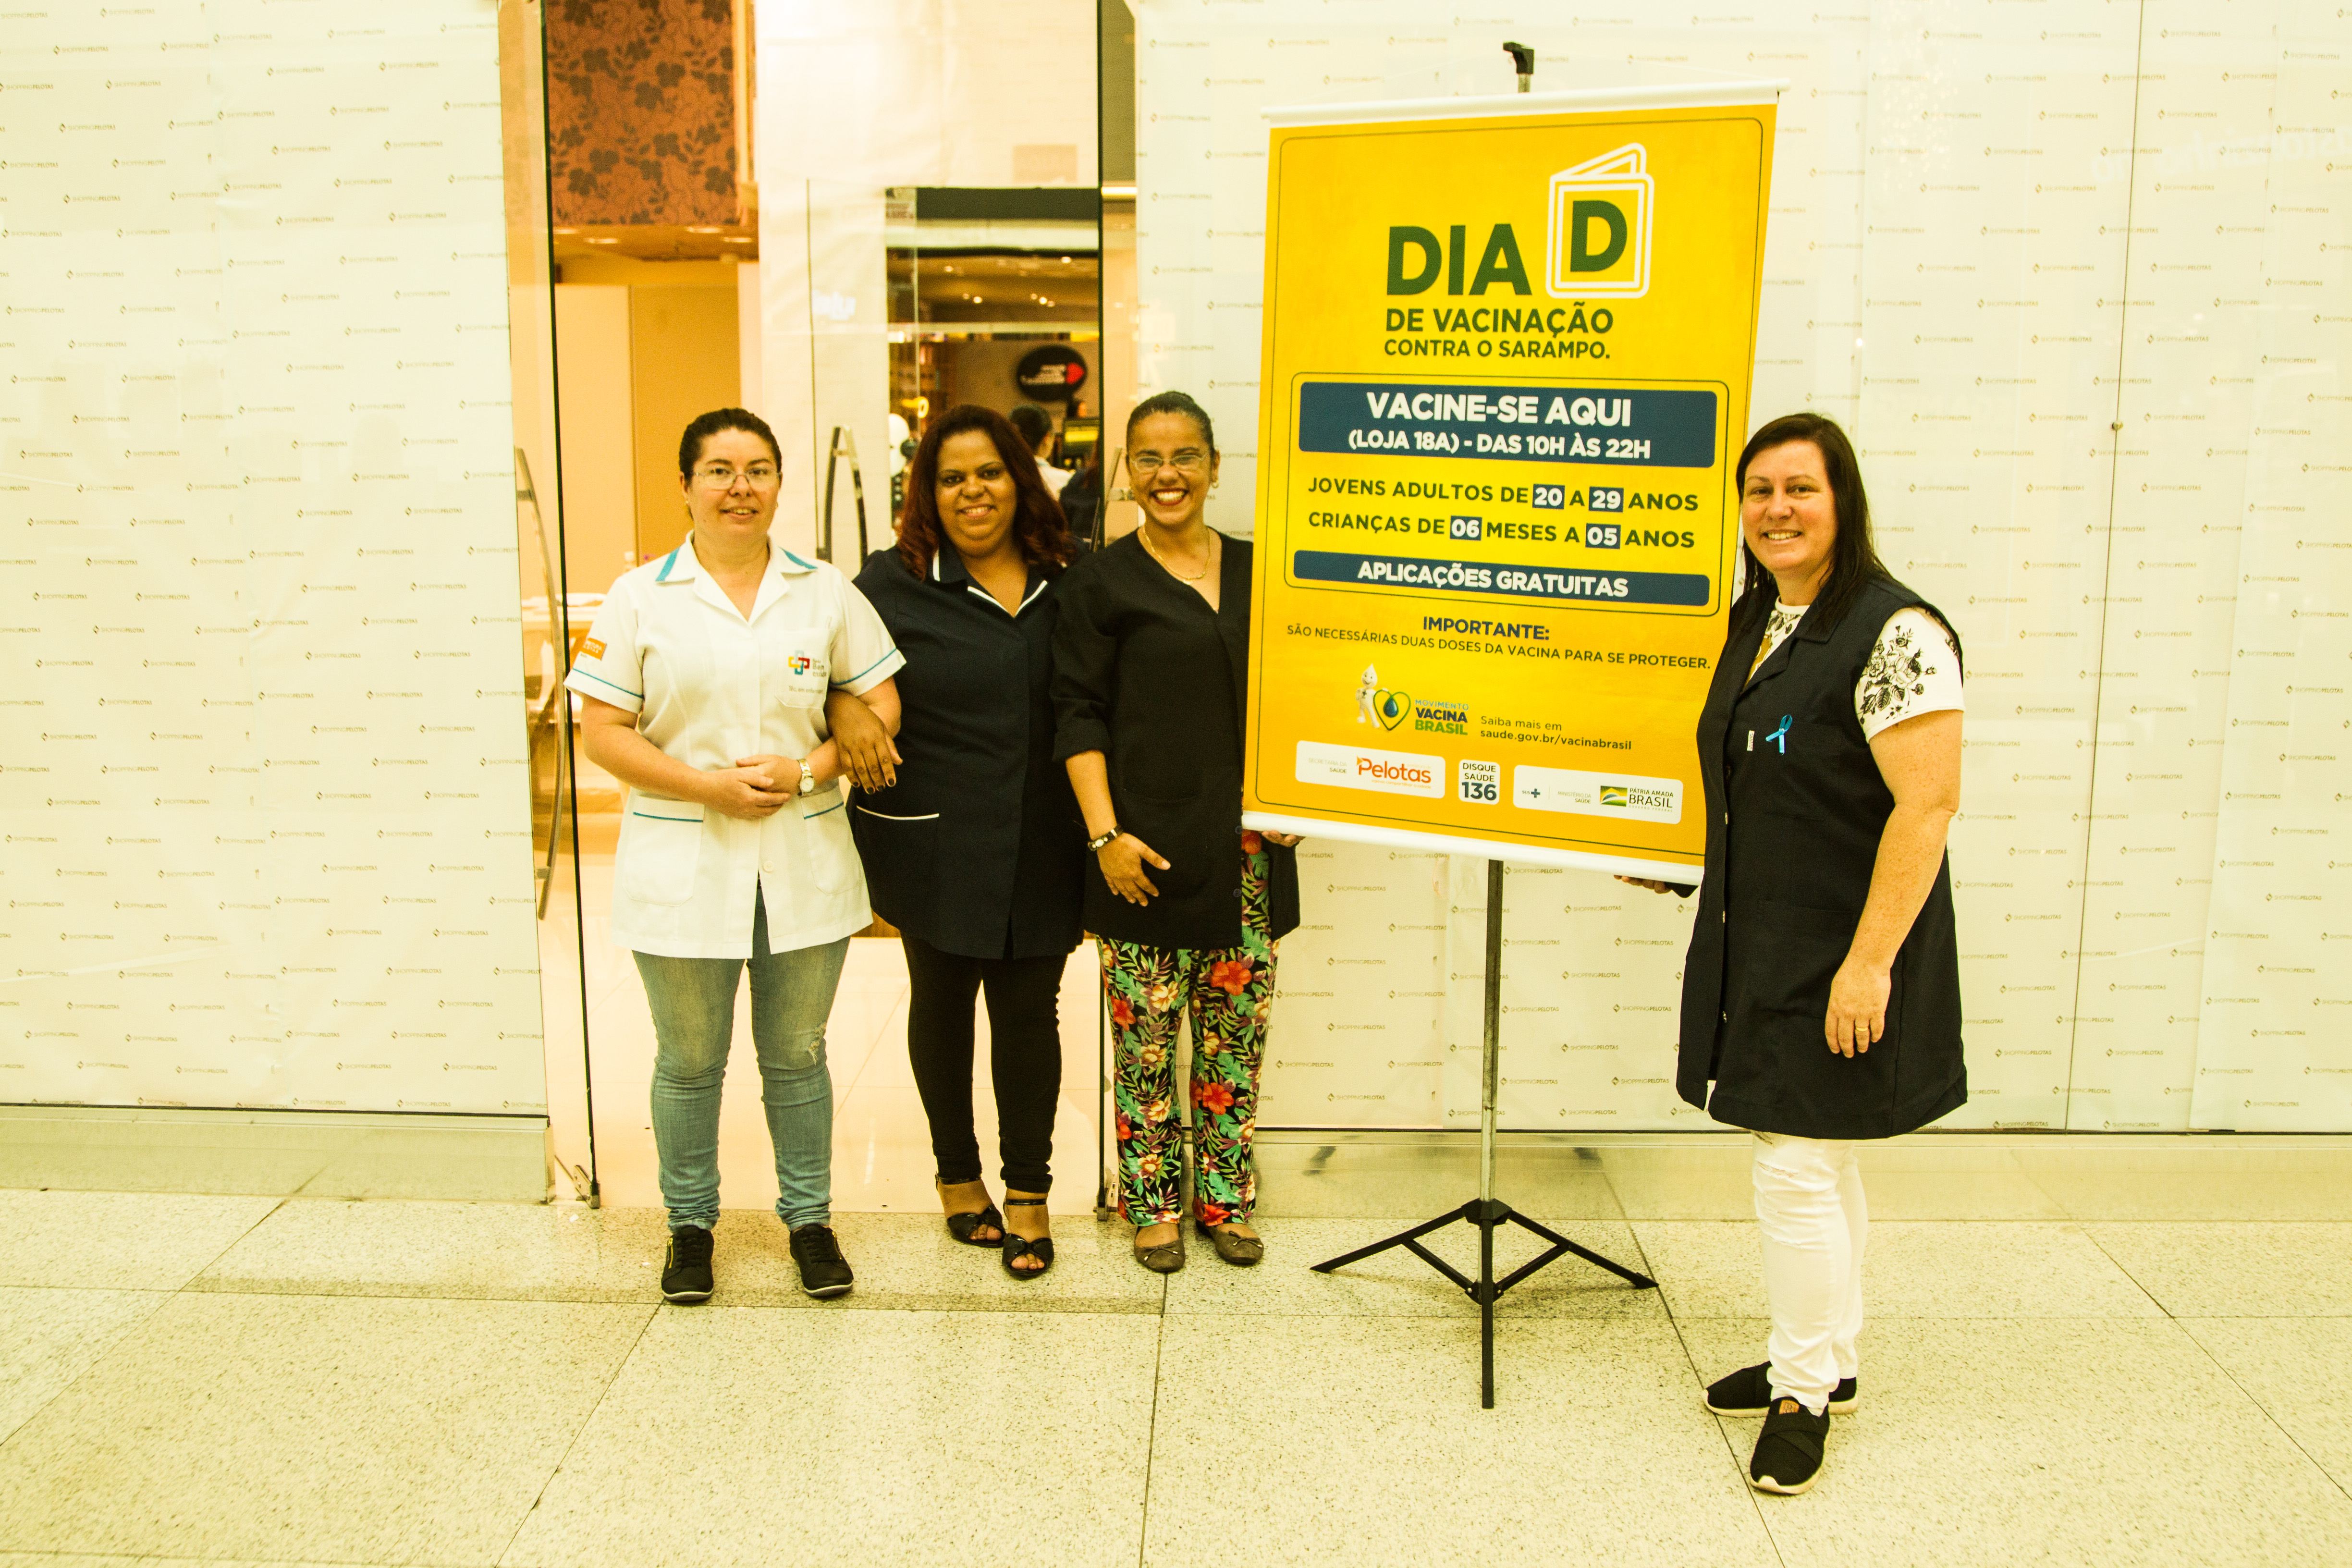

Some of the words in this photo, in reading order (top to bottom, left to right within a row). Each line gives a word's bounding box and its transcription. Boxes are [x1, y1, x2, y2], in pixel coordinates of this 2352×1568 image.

[1386, 223, 1532, 295] DIA
[1570, 200, 1628, 272] D
[1385, 309, 1424, 332] DE
[1433, 301, 1614, 338] VACINAÇÃO
[1384, 339, 1471, 357] CONTRA
[1477, 340, 1493, 357] O
[1499, 340, 1610, 359] SARAMPO.
[1367, 392, 1539, 424] VACINE-SE
[1544, 397, 1630, 429] AQUI
[1348, 429, 1409, 450] (LOJA
[1414, 431, 1459, 453] 18A)
[1477, 433, 1522, 454] DAS
[1528, 435, 1563, 456] 10H
[1569, 432, 1601, 458] ÀS
[1605, 438, 1651, 459] 22H
[1308, 478, 1385, 496] JOVENS
[1392, 481, 1493, 502] ADULTOS
[1502, 488, 1528, 503] DE
[1535, 488, 1563, 506] 20
[1569, 490, 1585, 506] A
[1592, 490, 1622, 509] 29
[1628, 492, 1698, 511] ANOS
[1308, 512, 1411, 534] CRIANÇAS
[1418, 517, 1445, 534] DE
[1452, 519, 1480, 538] 06
[1486, 522, 1557, 541] MESES
[1564, 527, 1580, 543] A
[1587, 527, 1617, 545] 05
[1625, 530, 1694, 548] ANOS
[1358, 561, 1491, 588] APLICAÇÕES
[1496, 571, 1628, 597] GRATUITAS
[1423, 616, 1549, 640] IMPORTANTE:
[1287, 623, 1311, 637] SÃO
[1315, 628, 1397, 644] NECESSÁRIAS
[1401, 636, 1434, 648] DUAS
[1439, 639, 1481, 652] DOSES
[1485, 643, 1503, 654] DA
[1508, 645, 1560, 659] VACINA
[1565, 649, 1603, 662] PARA
[1608, 653, 1624, 663] SE
[1629, 654, 1710, 669] PROTEGER.
[1415, 699, 1469, 710] MOVIMENTO
[1415, 708, 1468, 723] VACINA
[1481, 716, 1511, 726] Saiba
[1516, 719, 1541, 729] mais
[1545, 723, 1562, 731] em
[1415, 719, 1468, 735] BRASIL
[1481, 729, 1631, 750] saude.gov.br/vacinabrasil
[1309, 758, 1338, 766] SECRETARIA
[1357, 756, 1431, 783] Pelotas
[1463, 763, 1496, 772] DISQUE
[1464, 772, 1494, 782] SAÚDE
[1462, 782, 1497, 801] 136
[1629, 794, 1673, 808] BRASIL
